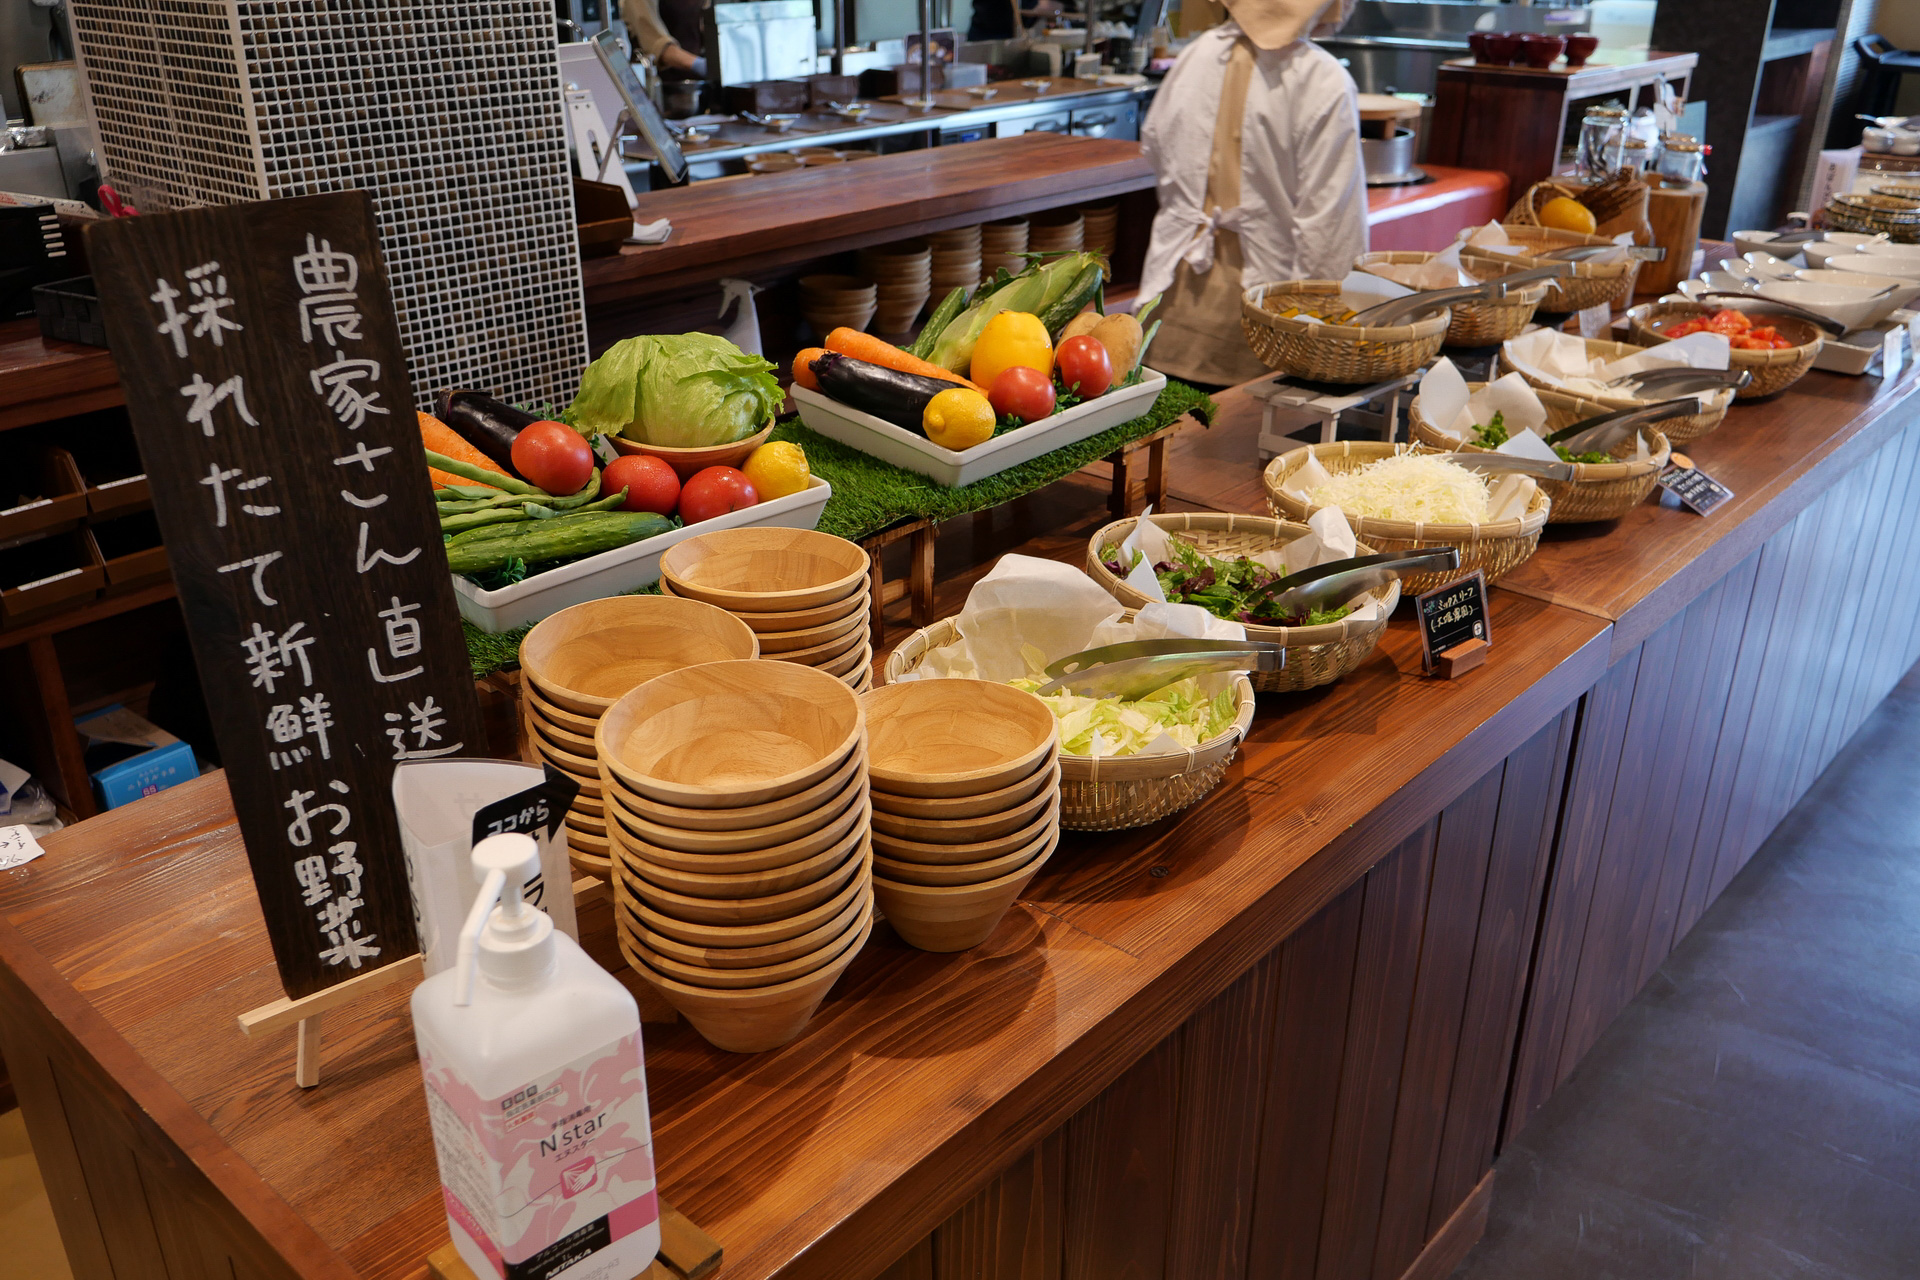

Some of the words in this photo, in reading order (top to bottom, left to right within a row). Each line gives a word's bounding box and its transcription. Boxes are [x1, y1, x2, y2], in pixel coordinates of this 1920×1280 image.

[150, 261, 381, 969] 採れたて新鮮お野菜
[293, 232, 464, 760] 農家さん直送
[487, 798, 550, 838] ココから
[554, 1138, 596, 1163] エヌスター
